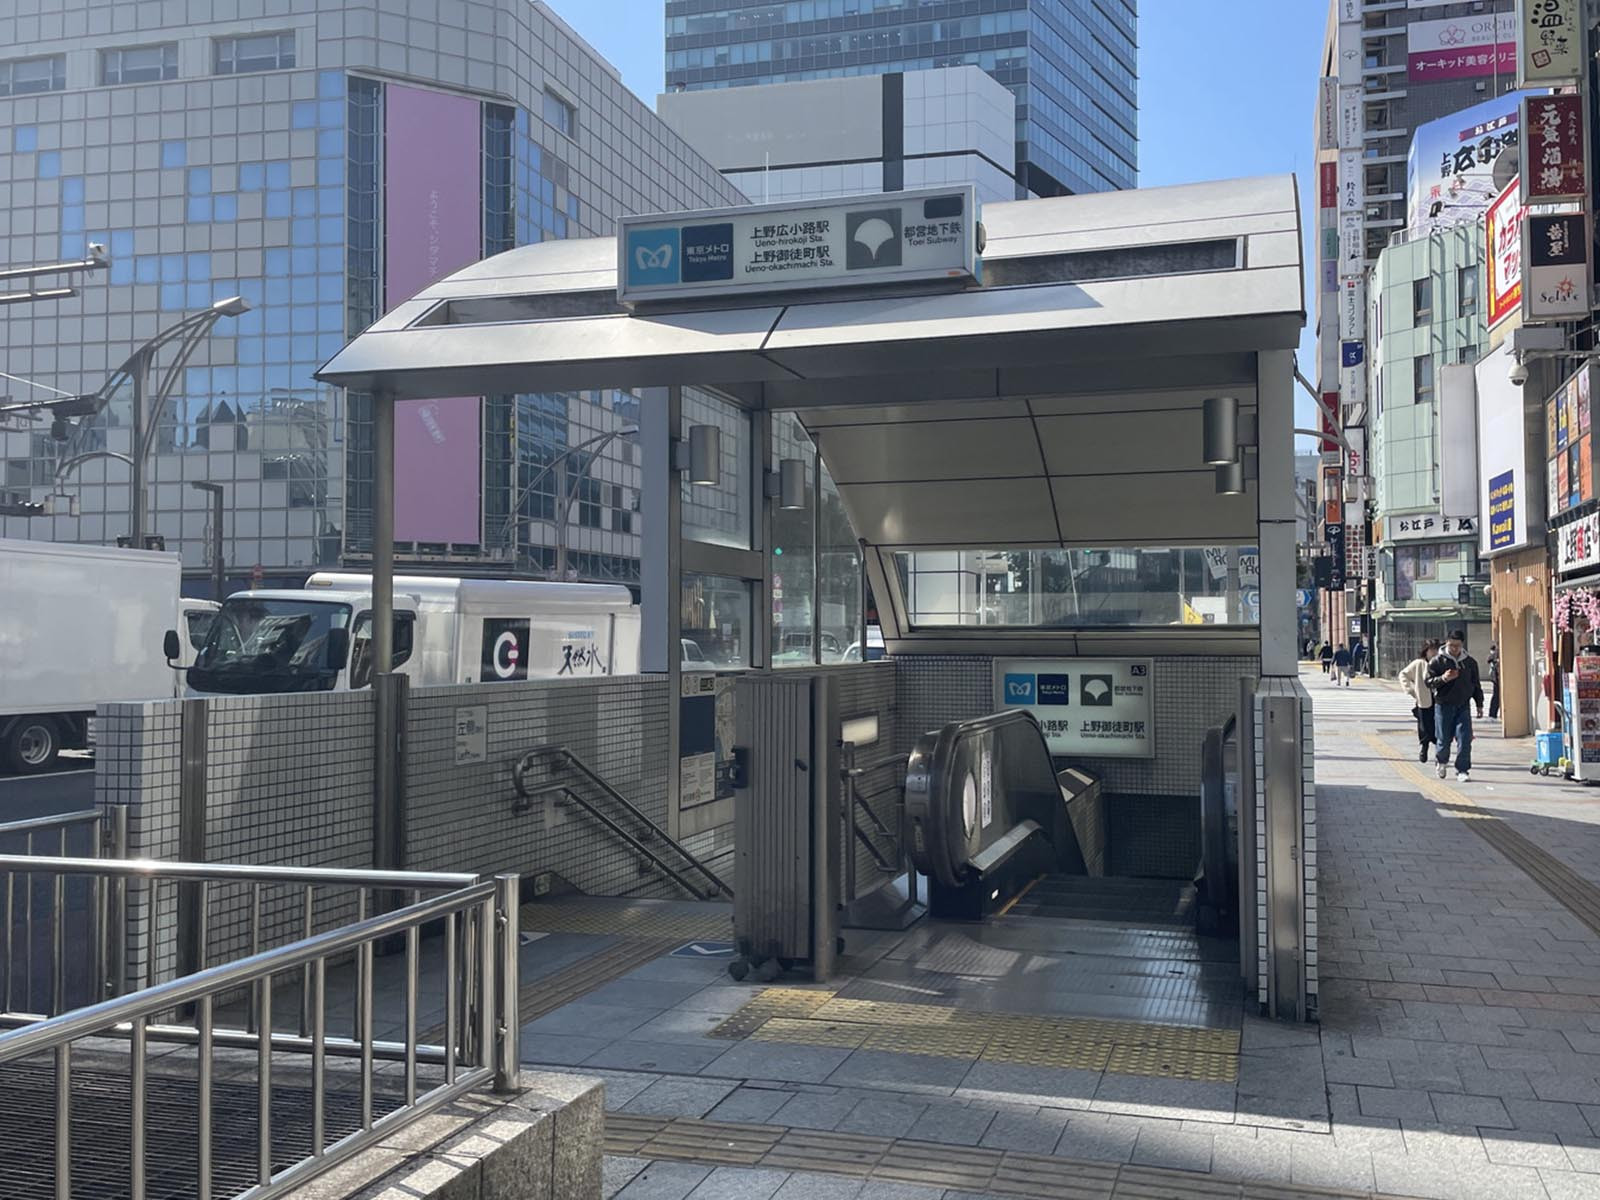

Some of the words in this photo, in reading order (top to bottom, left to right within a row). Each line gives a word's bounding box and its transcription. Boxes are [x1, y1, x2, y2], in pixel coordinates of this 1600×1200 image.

[1540, 103, 1564, 189] 元気酒場
[750, 220, 830, 239] 上野広小路駅
[904, 222, 962, 239] 都営地下鉄
[755, 236, 808, 248] Ueno-hirokoji
[809, 234, 825, 243] Sta.
[908, 238, 925, 246] Toei
[926, 236, 958, 245] Subway
[750, 245, 830, 264] 上野御徒町駅
[745, 261, 818, 273] Ueno-okachimachi
[1400, 518, 1434, 532] お江戸
[557, 643, 602, 676] 天然水
[1132, 665, 1146, 675] A3
[1080, 721, 1145, 733] 上野御徒町駅
